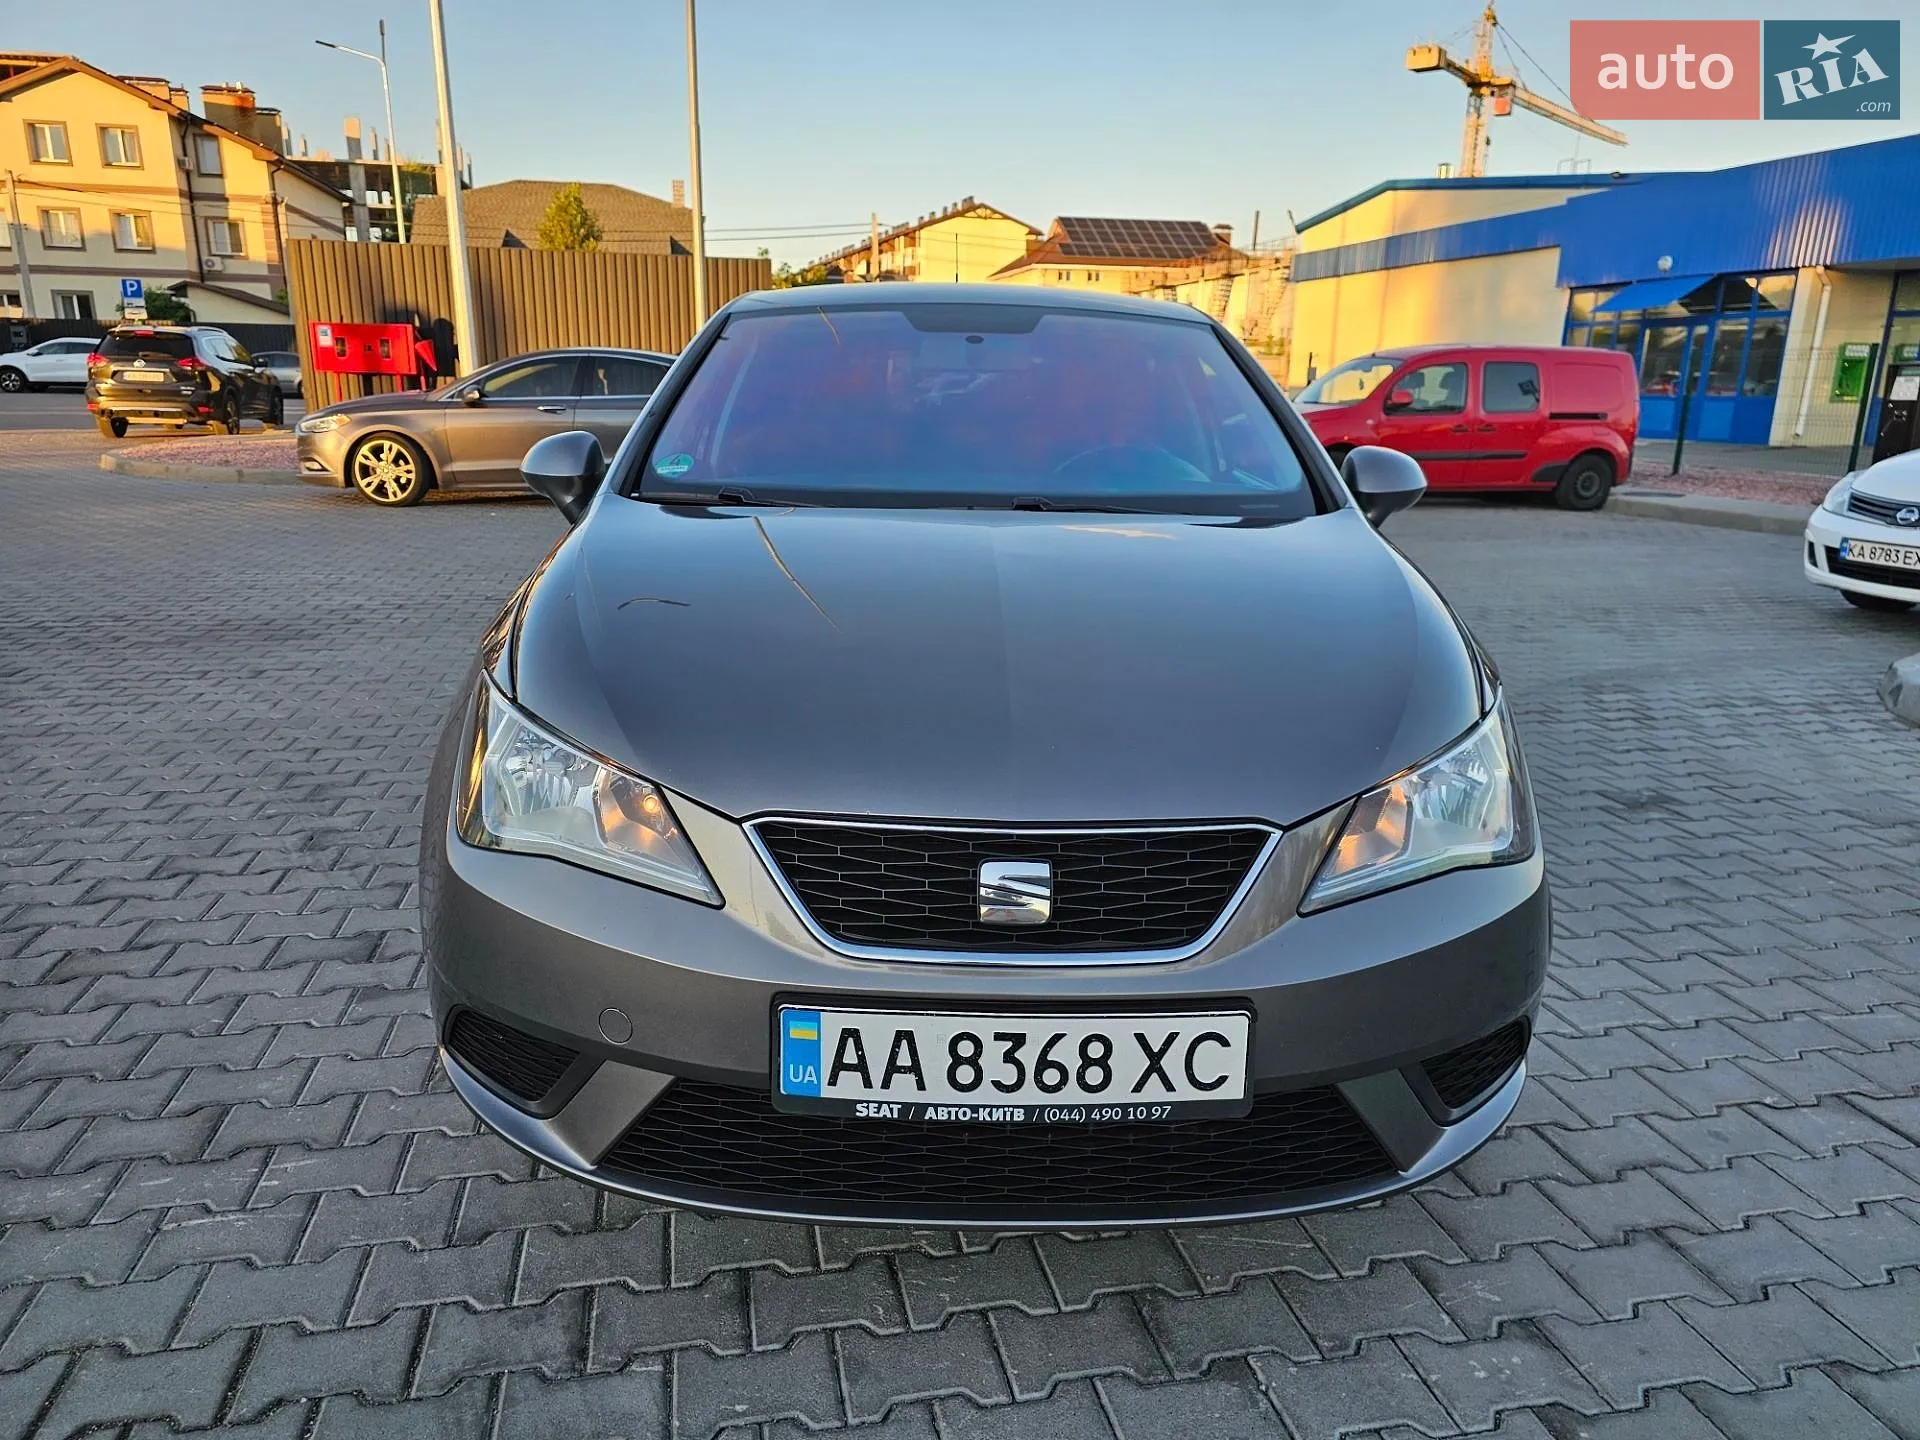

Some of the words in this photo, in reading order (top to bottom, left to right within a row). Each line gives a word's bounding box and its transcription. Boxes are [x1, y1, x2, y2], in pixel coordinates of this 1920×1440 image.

[126, 280, 138, 296] P
[1847, 543, 1865, 559] KA
[1869, 546, 1900, 563] 8783
[827, 1027, 927, 1091] AA
[946, 1031, 1114, 1093] 8368
[1130, 1031, 1231, 1093] XC
[789, 1064, 818, 1084] UA
[855, 1102, 902, 1119] SEAT
[1044, 1106, 1086, 1122] (044)
[1091, 1107, 1122, 1121] 490
[1127, 1107, 1146, 1120] 10
[1151, 1105, 1172, 1119] 97
